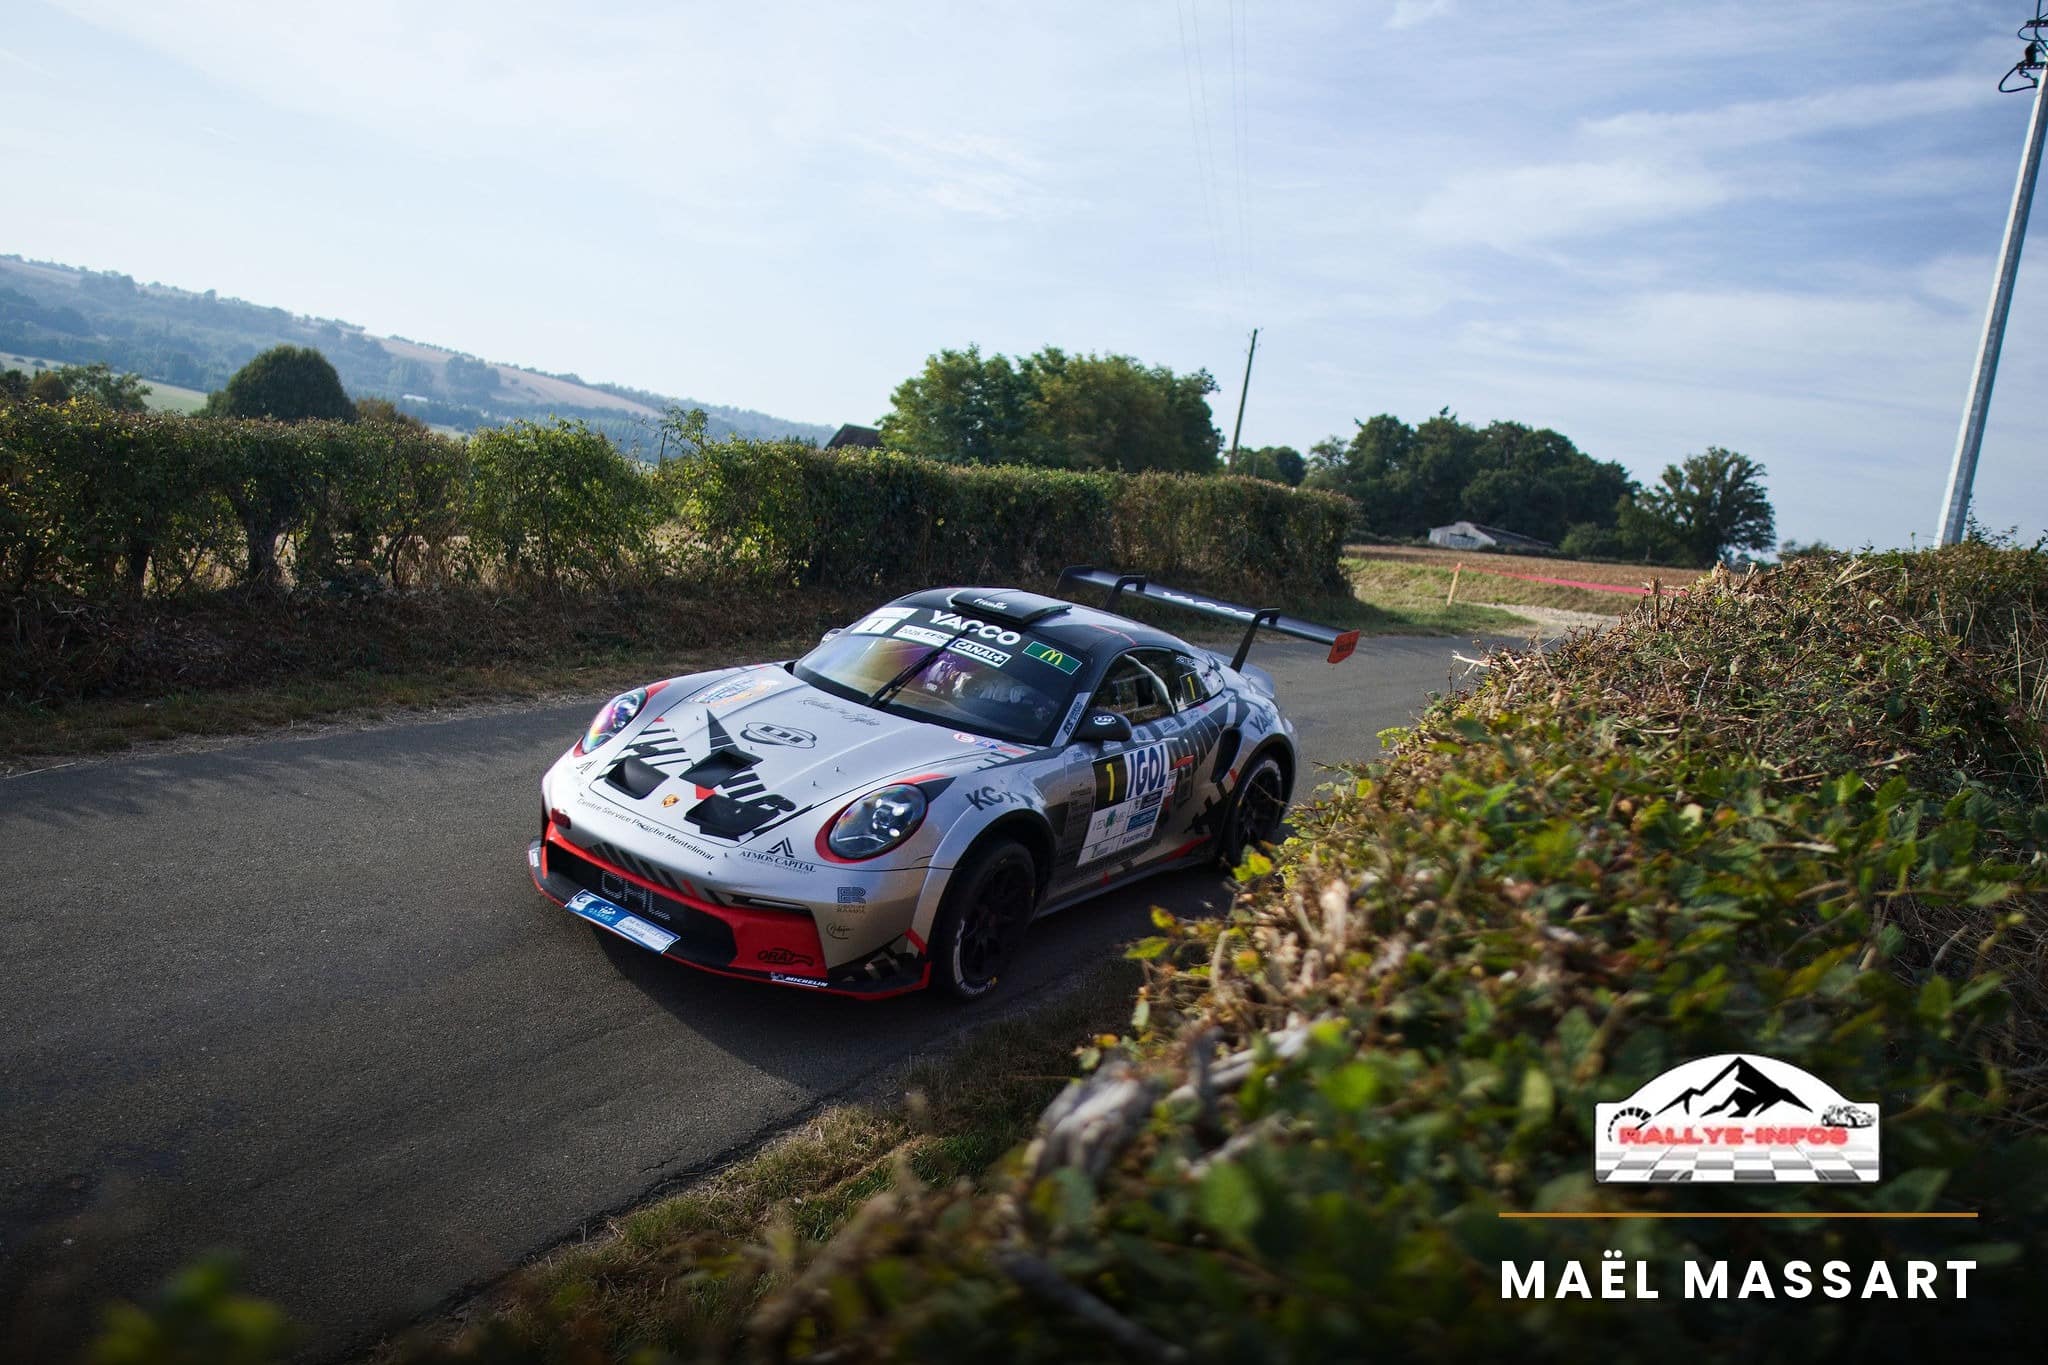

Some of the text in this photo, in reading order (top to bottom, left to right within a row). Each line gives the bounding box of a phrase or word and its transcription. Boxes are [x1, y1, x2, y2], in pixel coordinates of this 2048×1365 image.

[929, 610, 1021, 645] YACCO
[954, 640, 1005, 662] CANAL+
[1186, 676, 1196, 700] 1
[1105, 763, 1115, 801] 1
[1127, 744, 1167, 799] IGOL
[602, 806, 631, 823] Service
[632, 818, 665, 838] Porsche
[740, 850, 774, 863] ATMOS
[775, 858, 817, 873] CAPITAL
[784, 976, 829, 988] MICHELIN
